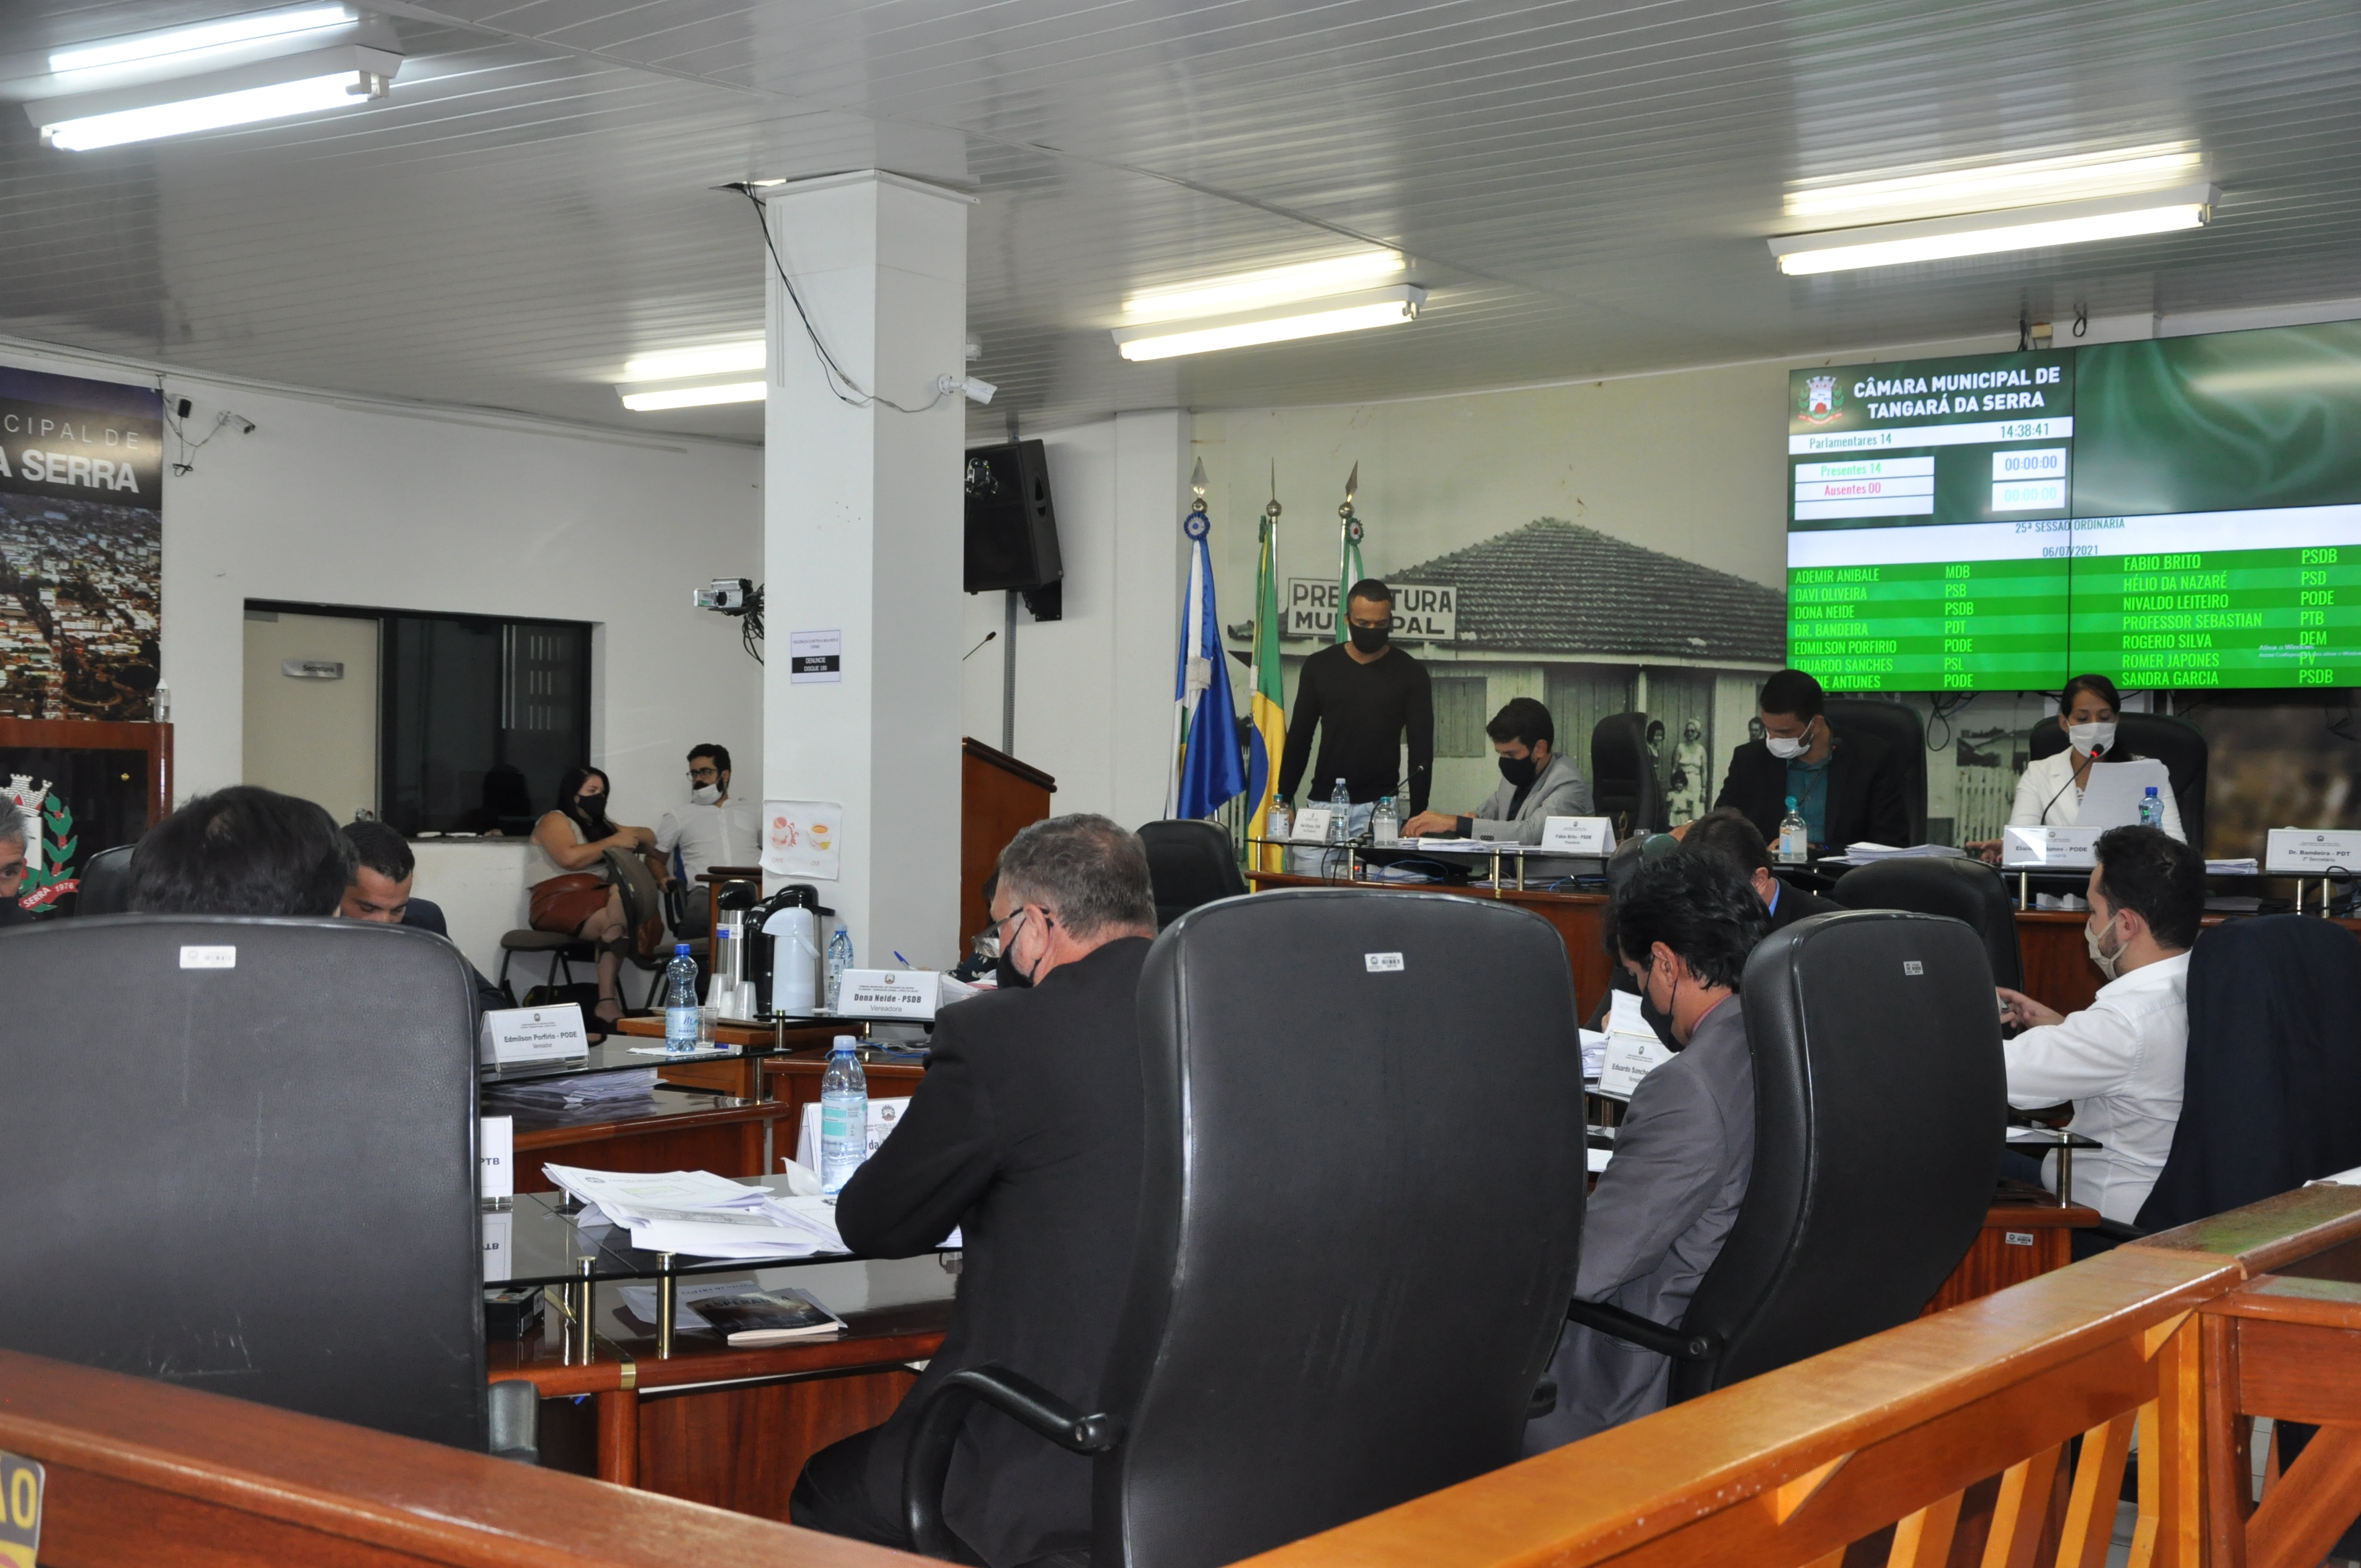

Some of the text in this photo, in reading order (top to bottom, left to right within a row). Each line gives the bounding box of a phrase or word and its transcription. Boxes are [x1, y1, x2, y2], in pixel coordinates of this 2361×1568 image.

[1854, 366, 2060, 398] CÂMARA MUNICIPAL DE
[1868, 391, 2044, 418] TANGARÁ DA SERRA
[105, 428, 139, 449] DE
[2000, 423, 2049, 439] 14:38:41
[1810, 434, 1891, 449] Parlamentares 14
[1821, 463, 1881, 477] Presentes 14
[2005, 455, 2057, 471] 00:00:00
[21, 449, 140, 493] SERRA
[1824, 482, 1881, 496] Ausentes 00
[2004, 487, 2057, 502] 00:00:00
[2043, 545, 2098, 557] 06/07/2021
[2302, 548, 2337, 564] PSDB
[2124, 553, 2201, 571] FABIO BRITO
[1795, 568, 1880, 584] ADEMIR ANIBALE
[1945, 565, 1971, 579] MDB
[2302, 570, 2326, 586] PSD
[2124, 570, 2227, 592] HÉLIO DA NAZARÉ
[1795, 587, 1867, 602] DAVI OLIVEIRA
[1945, 584, 1967, 597] PSB
[2301, 590, 2334, 606] PODE
[1945, 602, 1974, 616] PSDB
[2123, 594, 2229, 611] NIVALDO LEITEIRO
[1795, 605, 1855, 620] DONA NEIDE
[2300, 611, 2325, 625] PTB
[1945, 620, 1966, 634] PDT
[2123, 612, 2262, 630] PROFESSOR SEBASTIAN
[1794, 623, 1869, 637] DR. BANDEIRA
[2300, 630, 2327, 645] DEM
[1794, 640, 1897, 655] EDMILSON PORFIRIO
[1945, 639, 1973, 653] PODE
[2123, 634, 2212, 650] ROGERIO SILVA
[1794, 658, 1894, 672] EDUARDO SANCHES
[1944, 657, 1964, 671] PSL
[2123, 655, 2164, 668] ROMER
[2299, 651, 2316, 665] PV
[1832, 675, 1881, 688] ANTUNES
[1944, 674, 1973, 688] PODE
[2122, 671, 2219, 685] SANDRA GARCIA
[2299, 669, 2333, 684] PSDB
[55, 883, 74, 892] 1976
[23, 887, 51, 907] SERRA
[1612, 1063, 1650, 1075] Eduardo Sanche
[869, 1139, 879, 1150] da
